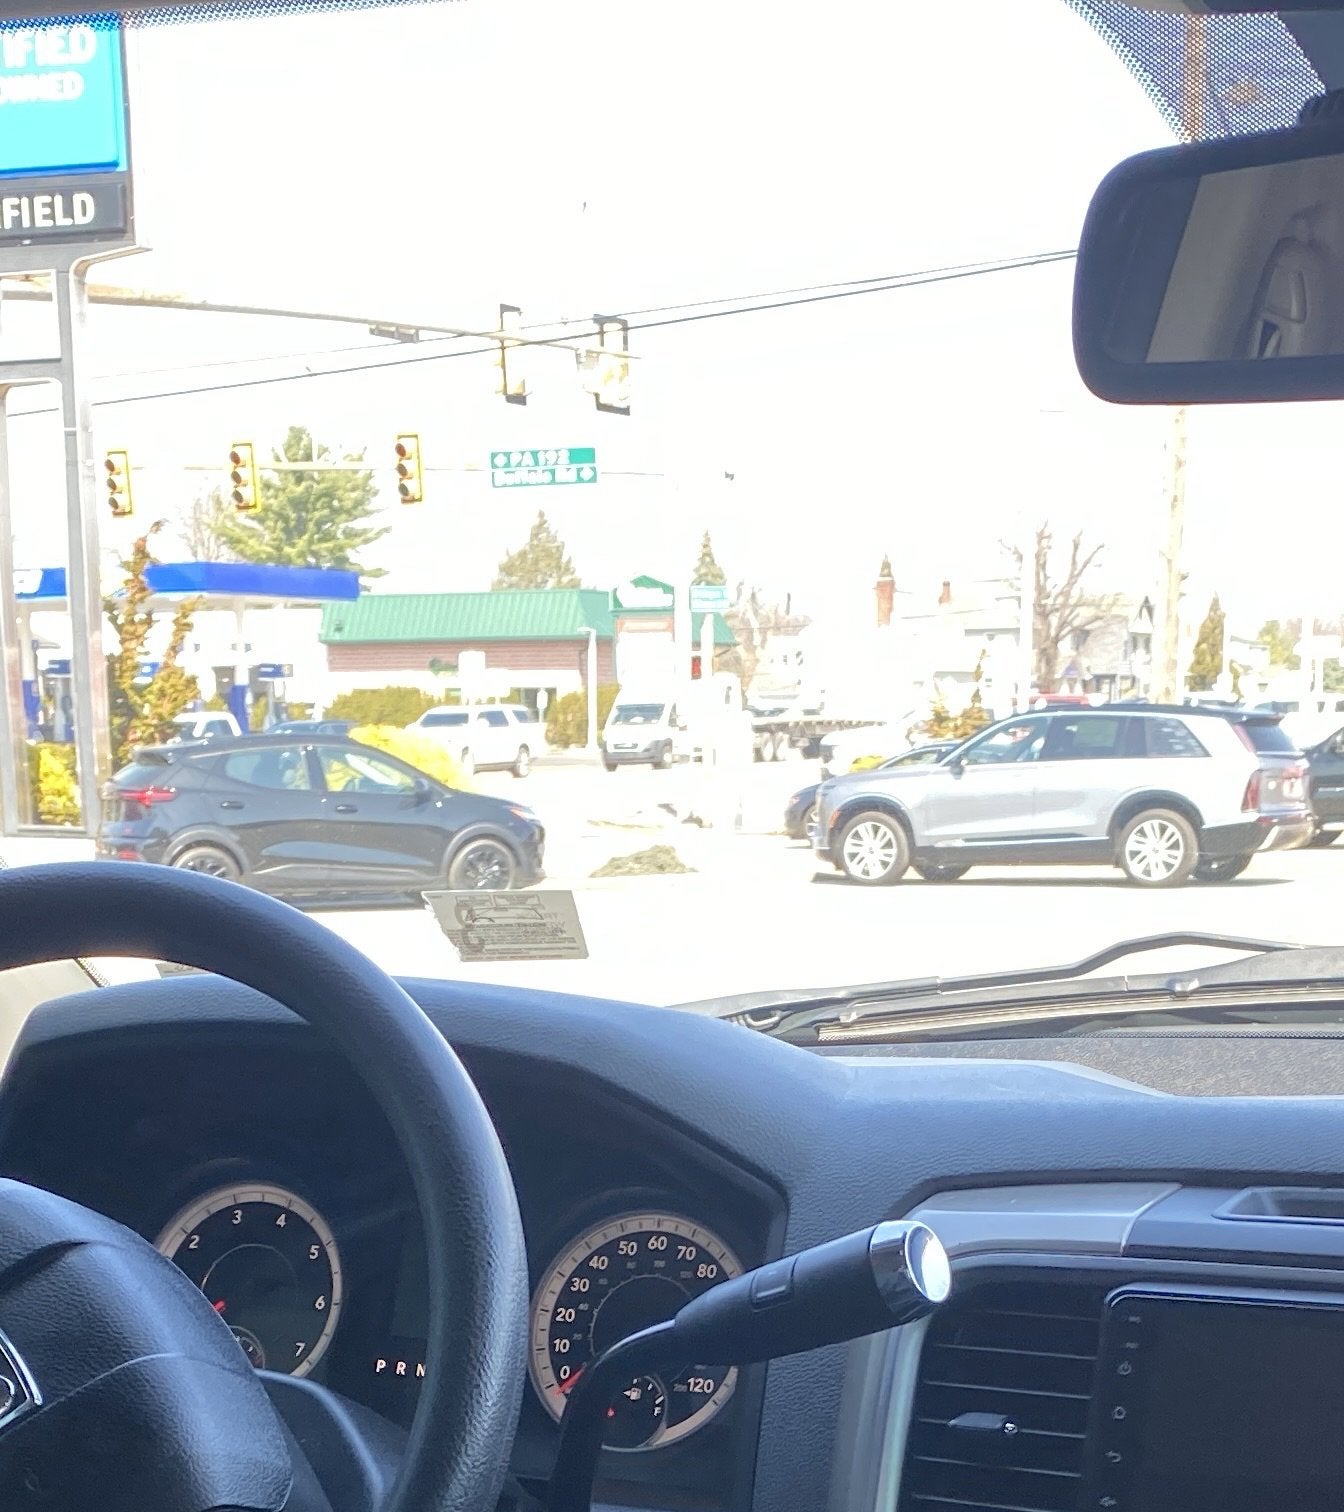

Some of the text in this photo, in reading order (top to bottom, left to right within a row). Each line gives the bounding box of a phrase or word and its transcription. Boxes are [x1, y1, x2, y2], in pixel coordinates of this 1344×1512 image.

[231, 1209, 243, 1225] 3
[275, 1213, 287, 1228] 4
[188, 1234, 201, 1250] 2
[617, 1241, 638, 1256] 50
[647, 1235, 668, 1251] 60
[309, 1245, 321, 1261] 5
[677, 1245, 697, 1261] 70
[588, 1255, 609, 1271] 40
[696, 1264, 718, 1279] 80
[570, 1278, 590, 1293] 30
[314, 1295, 326, 1310] 6
[555, 1308, 576, 1323] 20
[295, 1342, 306, 1358] 7
[553, 1338, 570, 1353] 10
[375, 1358, 387, 1373] P
[395, 1361, 407, 1376] R
[559, 1365, 571, 1379] 0
[687, 1377, 715, 1394] 120
